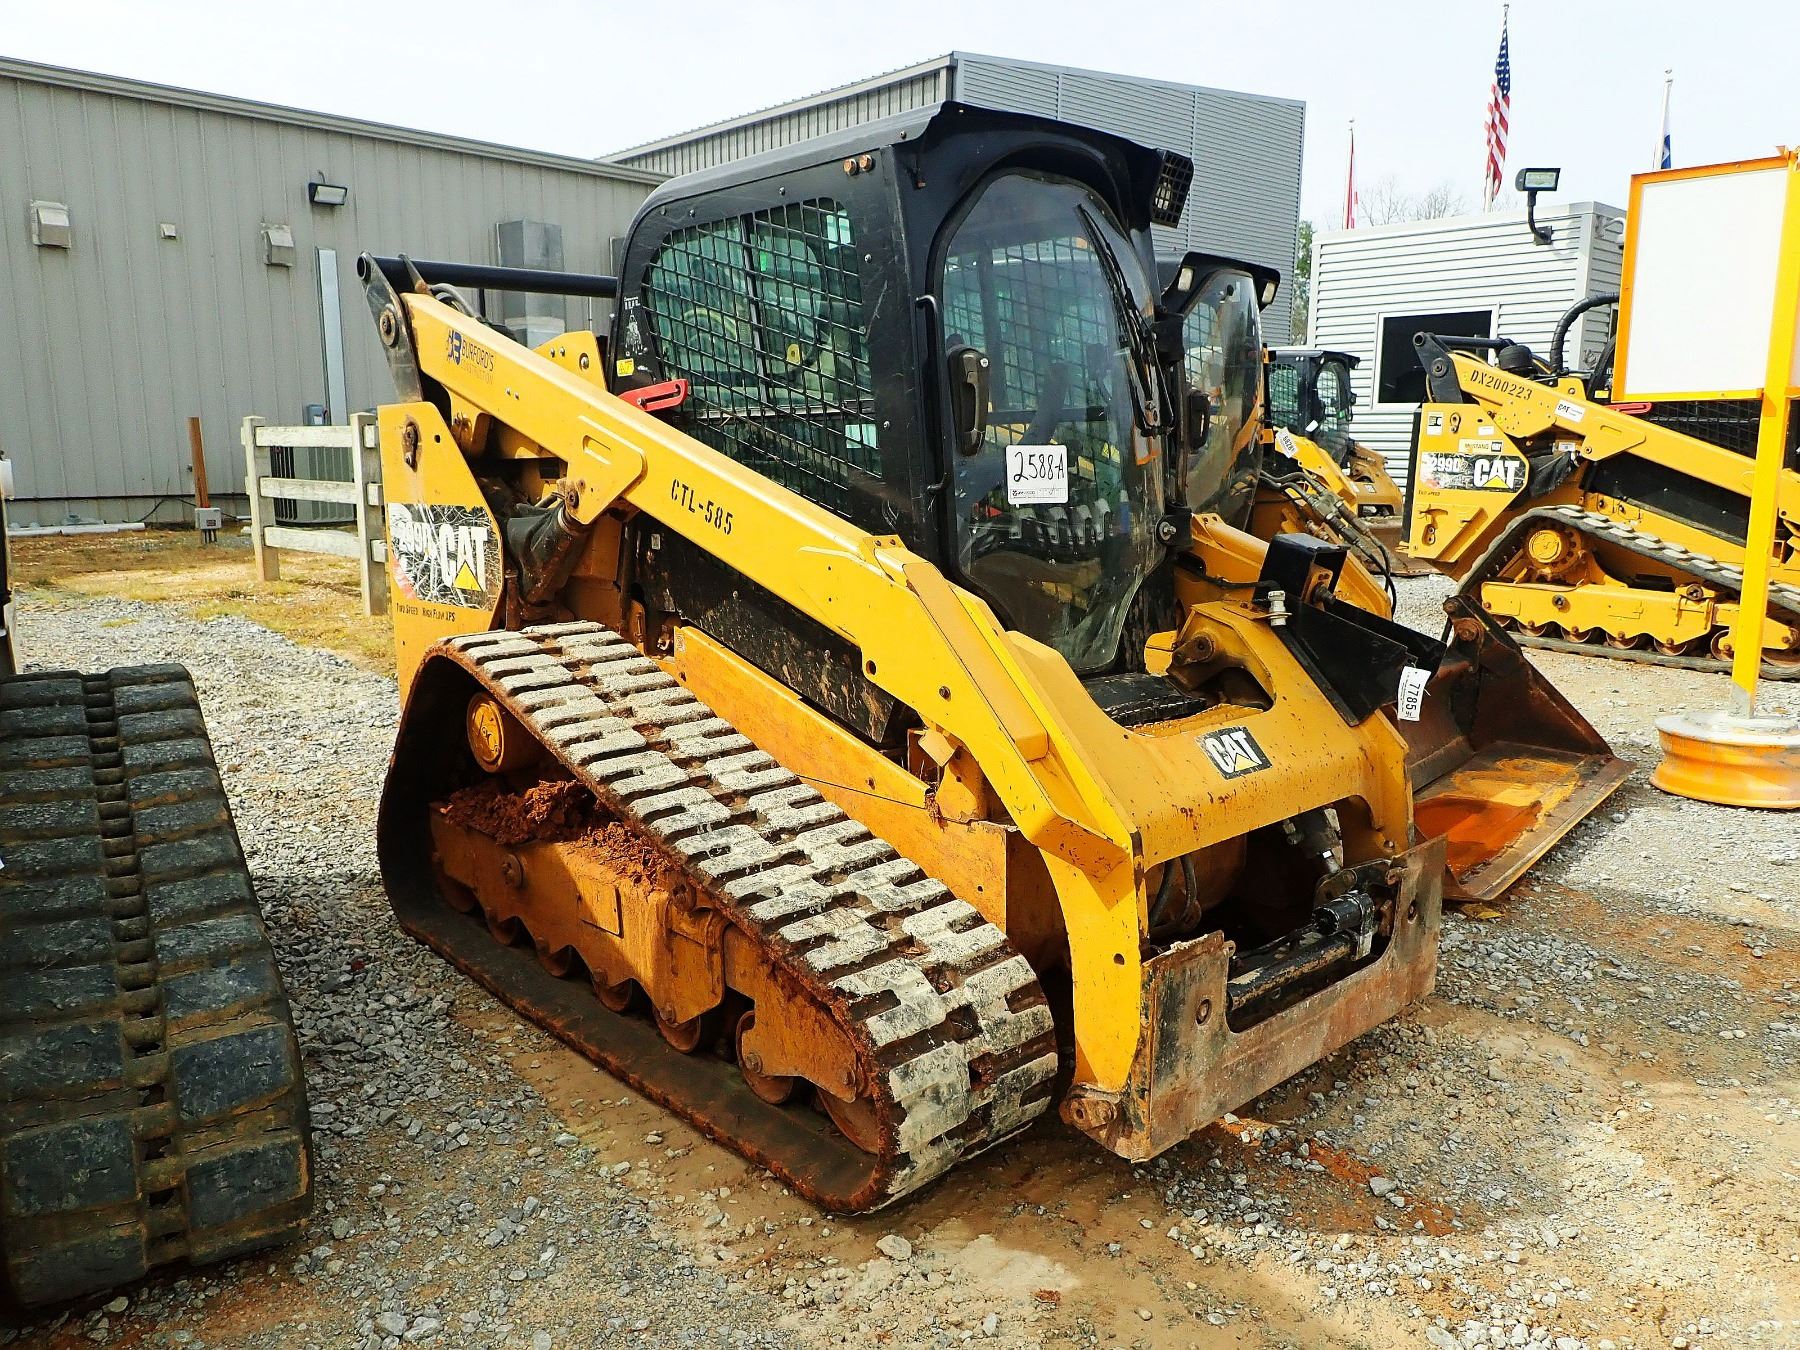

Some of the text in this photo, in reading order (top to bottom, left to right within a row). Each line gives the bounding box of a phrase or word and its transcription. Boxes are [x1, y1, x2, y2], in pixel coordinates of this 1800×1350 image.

[462, 339, 494, 372] BURFORD'S
[1470, 369, 1533, 400] DX200223
[1473, 458, 1520, 490] CAT
[671, 478, 734, 536] CTL-585
[438, 523, 488, 592] CAT
[1405, 683, 1421, 711] 7785
[1204, 730, 1263, 774] CAT
